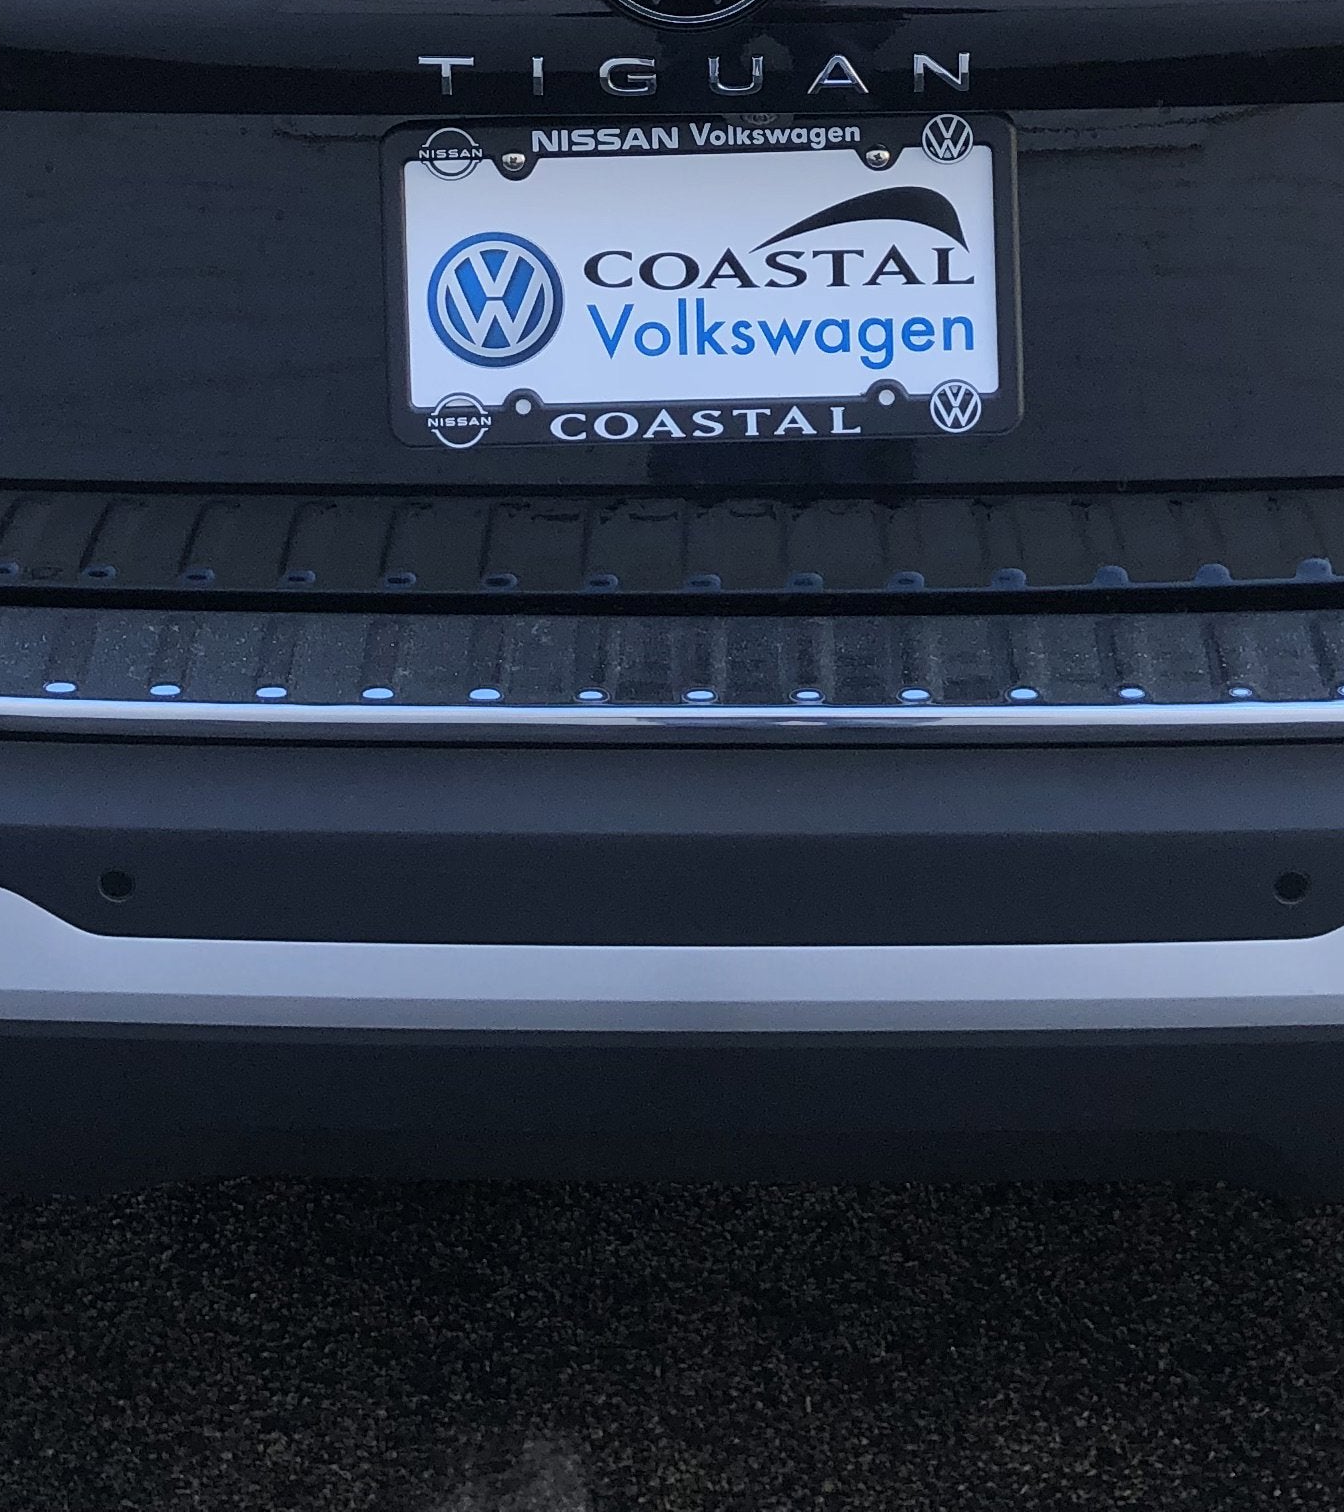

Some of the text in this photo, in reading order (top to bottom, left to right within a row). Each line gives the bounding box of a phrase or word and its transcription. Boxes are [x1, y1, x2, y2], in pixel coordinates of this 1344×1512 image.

[418, 52, 971, 96] TIGUAN
[419, 147, 483, 159] NISSAN
[532, 121, 861, 152] NISSAN Volkswagen
[583, 246, 975, 291] COASTAL
[587, 298, 975, 370] Volkswagen
[427, 415, 492, 428] NISSAN
[549, 405, 862, 441] COASTAL
